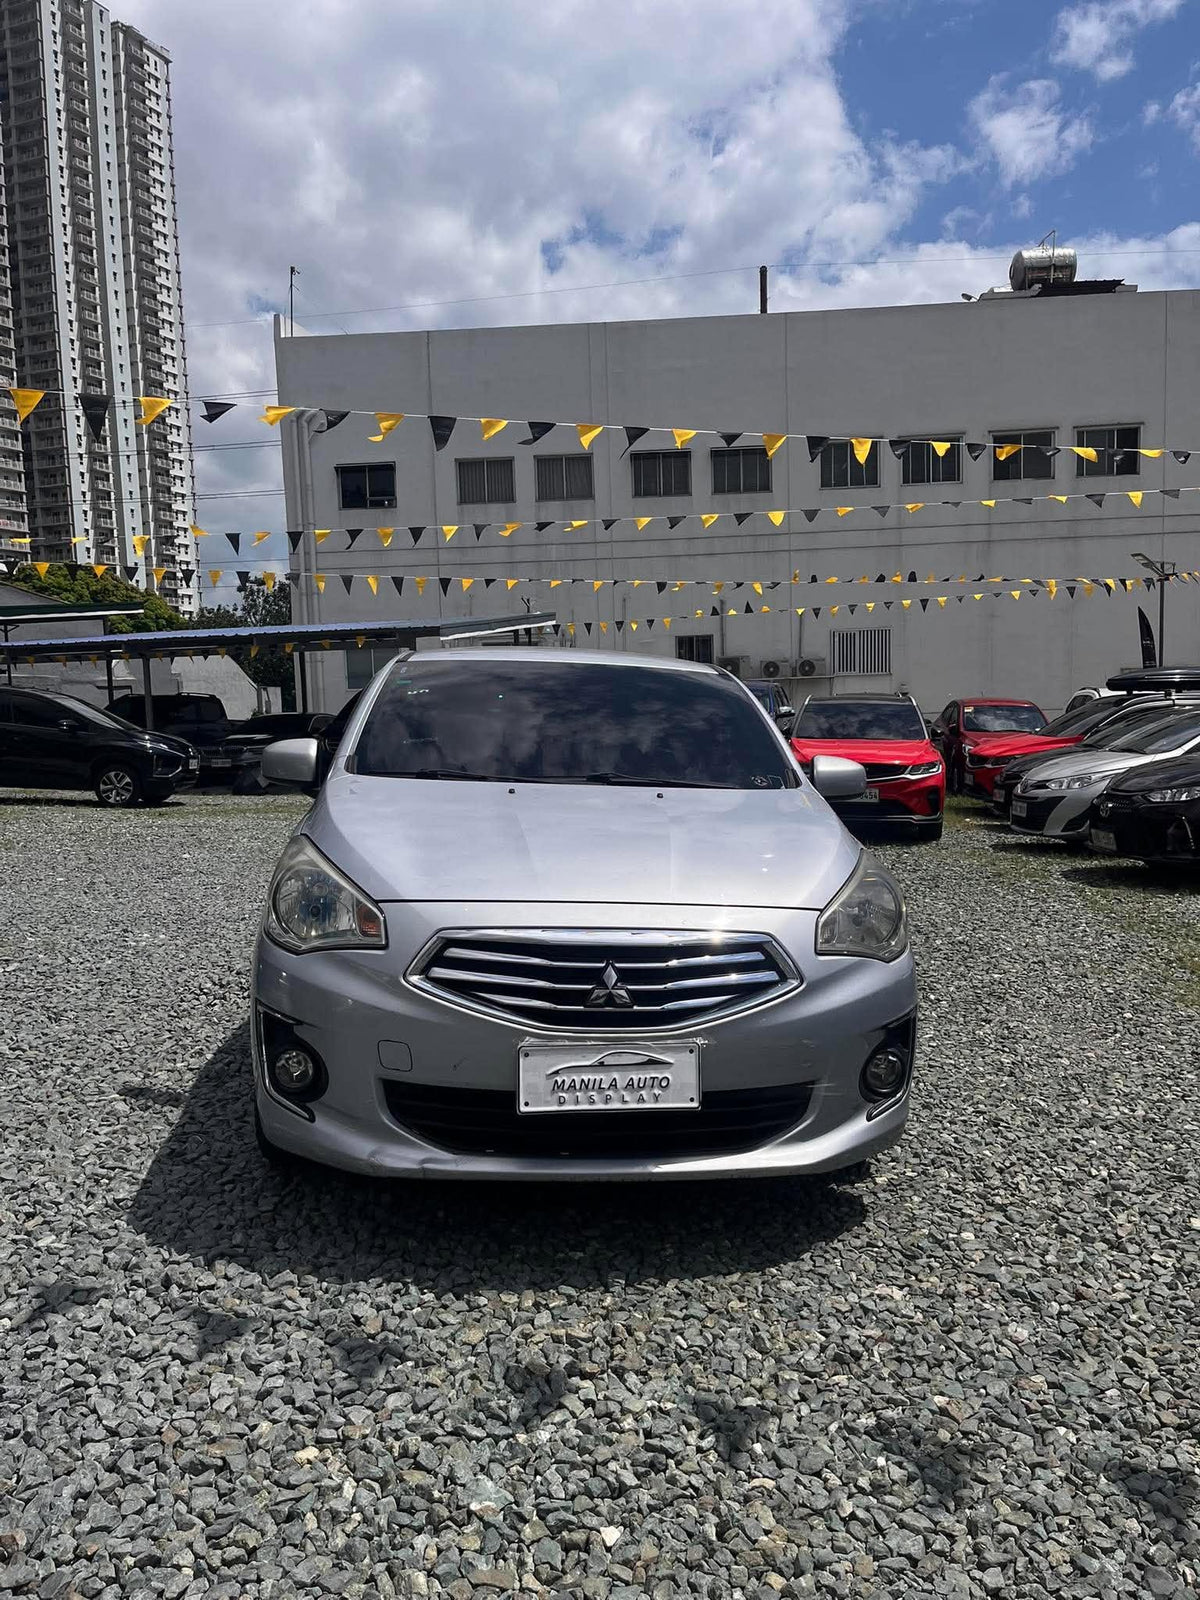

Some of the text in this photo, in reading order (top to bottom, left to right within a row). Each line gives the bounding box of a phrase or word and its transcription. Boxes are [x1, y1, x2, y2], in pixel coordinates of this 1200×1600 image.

[551, 1075, 671, 1092] MANILA AUTO
[557, 1093, 662, 1106] DISPLAY
